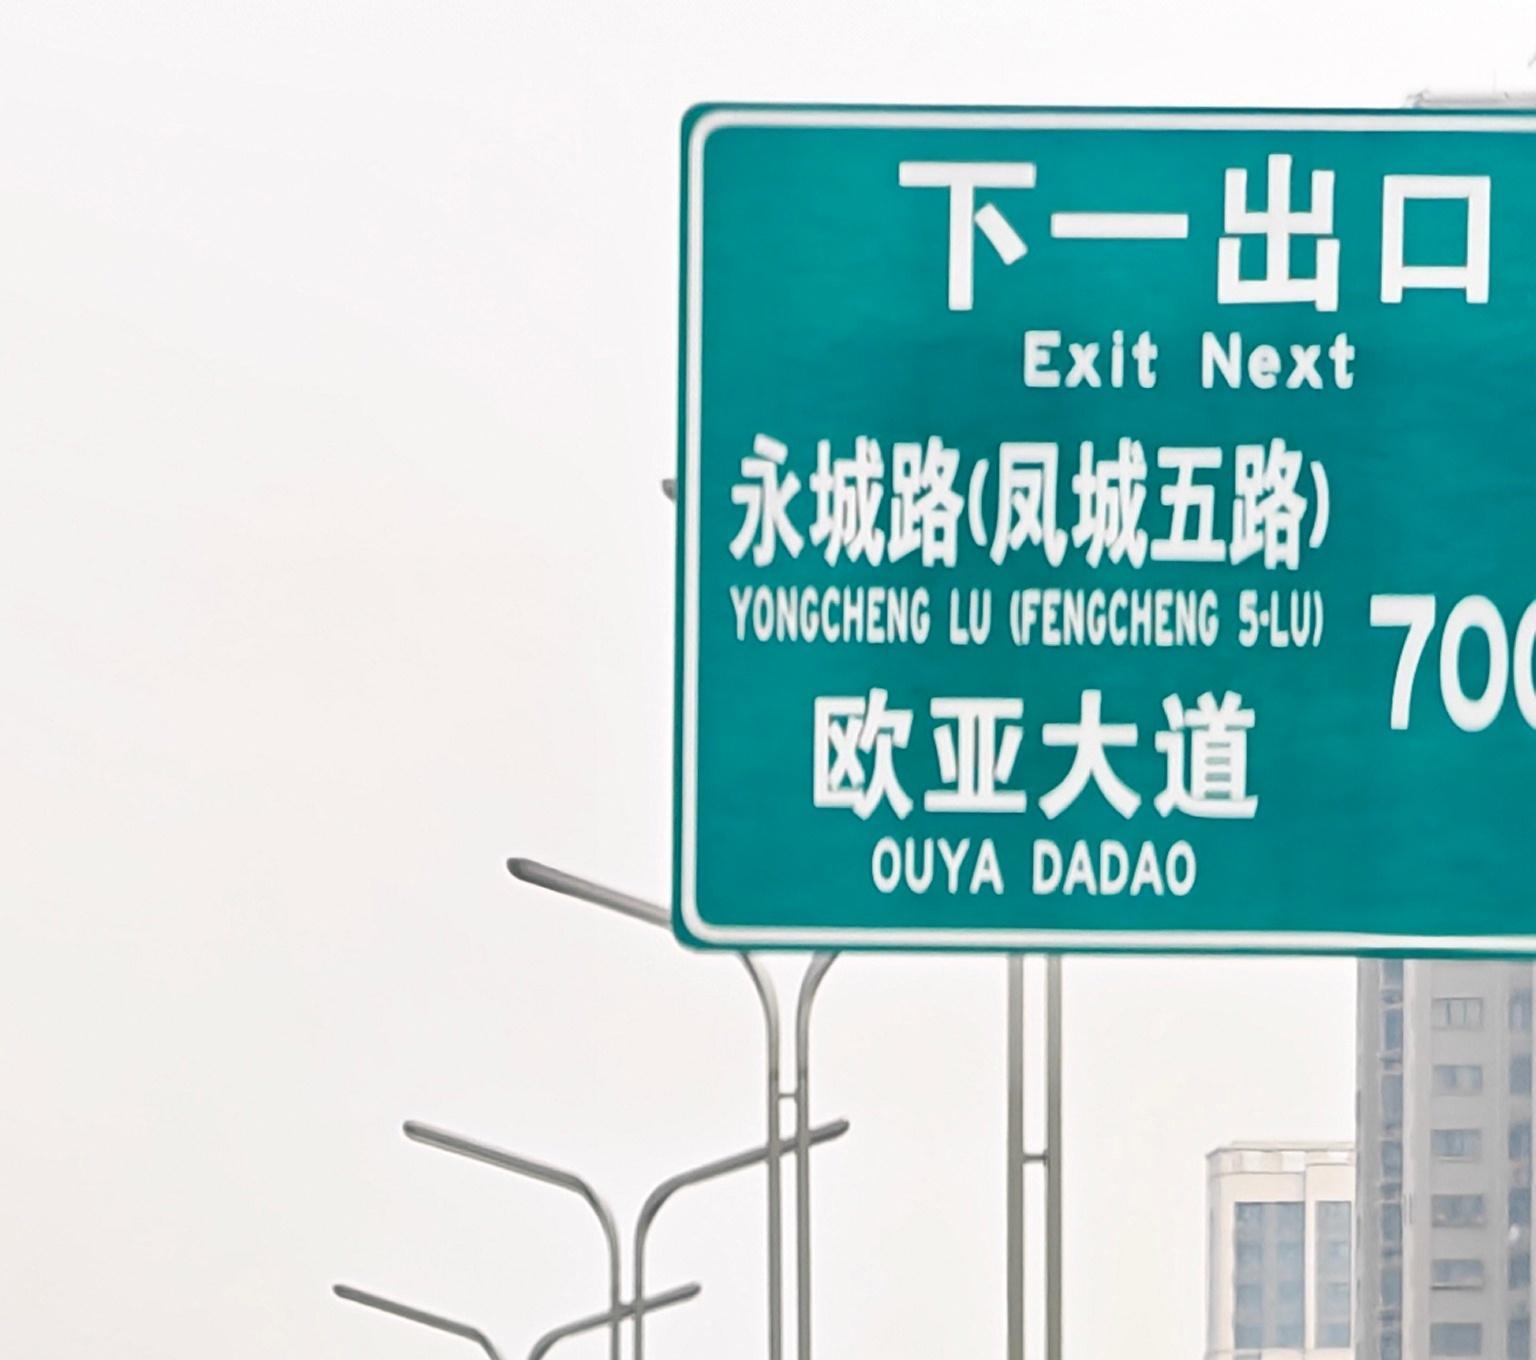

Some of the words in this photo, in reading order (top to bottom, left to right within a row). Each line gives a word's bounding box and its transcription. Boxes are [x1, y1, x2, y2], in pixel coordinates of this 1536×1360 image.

[899, 154, 1491, 311] 下一出口
[1024, 330, 1158, 388] Exit
[1201, 332, 1355, 388] Next
[730, 434, 1329, 569] 永城路(凤城五路)
[730, 586, 931, 643] YONGCHENG
[949, 590, 992, 644] LU
[1010, 588, 1219, 646] (FENGCHENG
[814, 688, 1258, 819] 欧亚大道
[871, 838, 1004, 894] OUYA
[1032, 840, 1196, 895] DADAO
